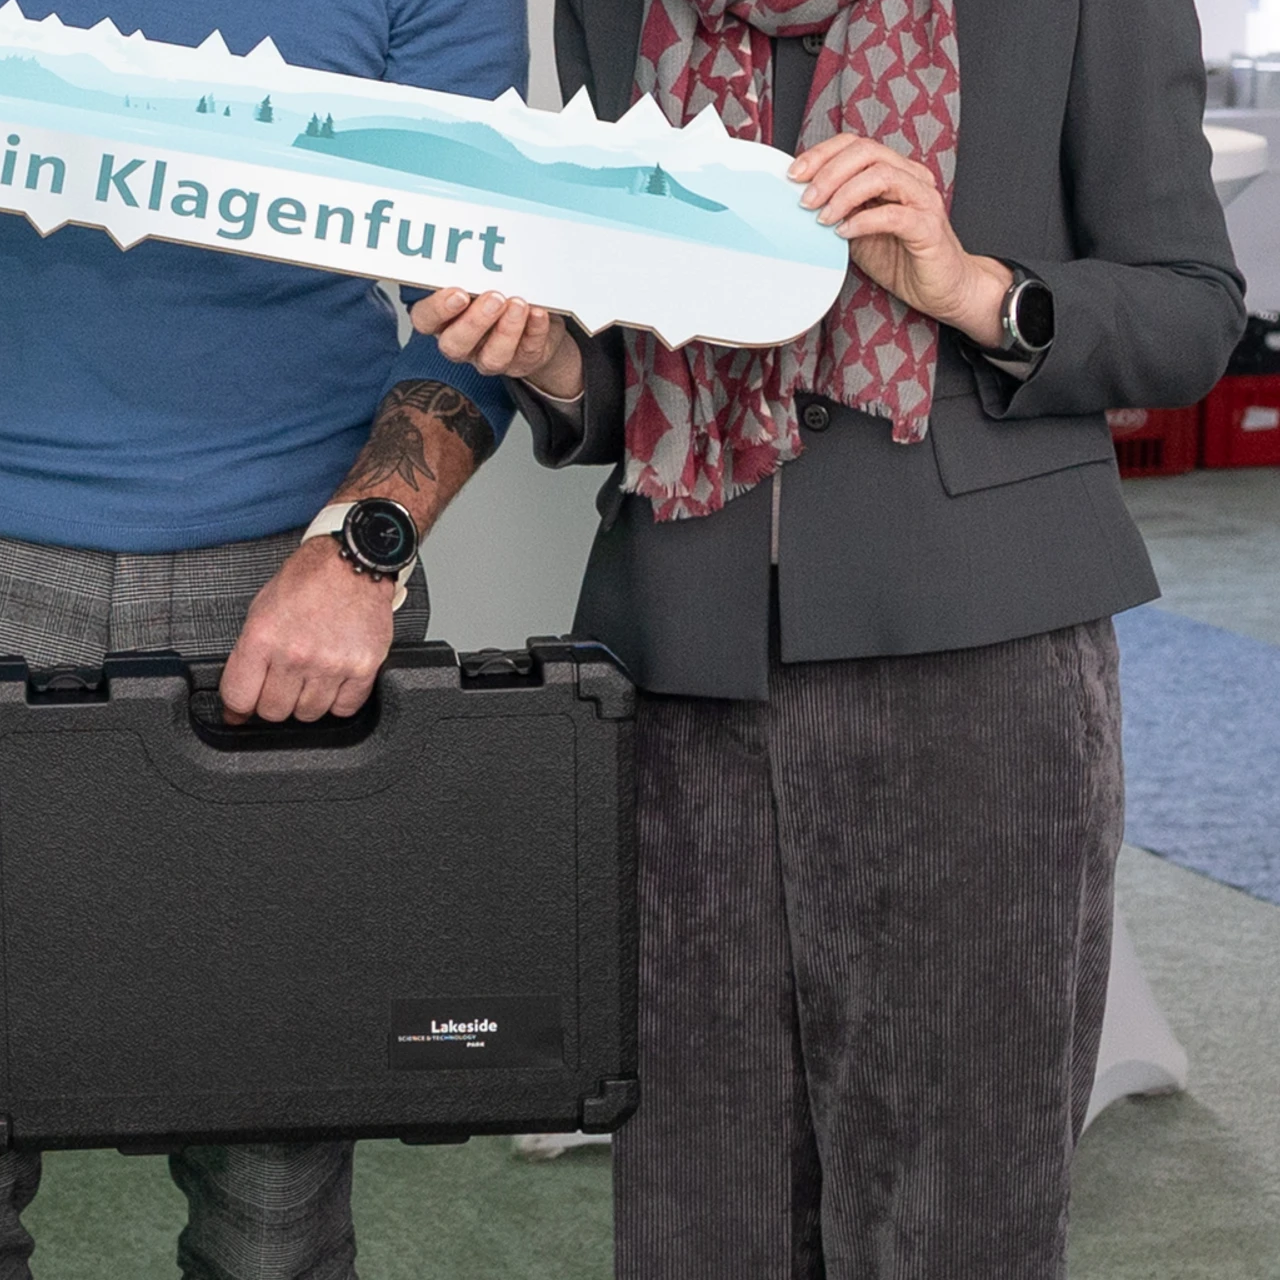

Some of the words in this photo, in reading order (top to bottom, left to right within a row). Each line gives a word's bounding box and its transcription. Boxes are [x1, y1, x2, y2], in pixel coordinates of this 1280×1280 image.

[1, 134, 65, 193] in
[96, 154, 506, 272] Klagenfurt
[430, 1018, 499, 1034] Lakeside
[398, 1034, 426, 1042] SCIENCE
[432, 1033, 477, 1041] TECHNOLOGY
